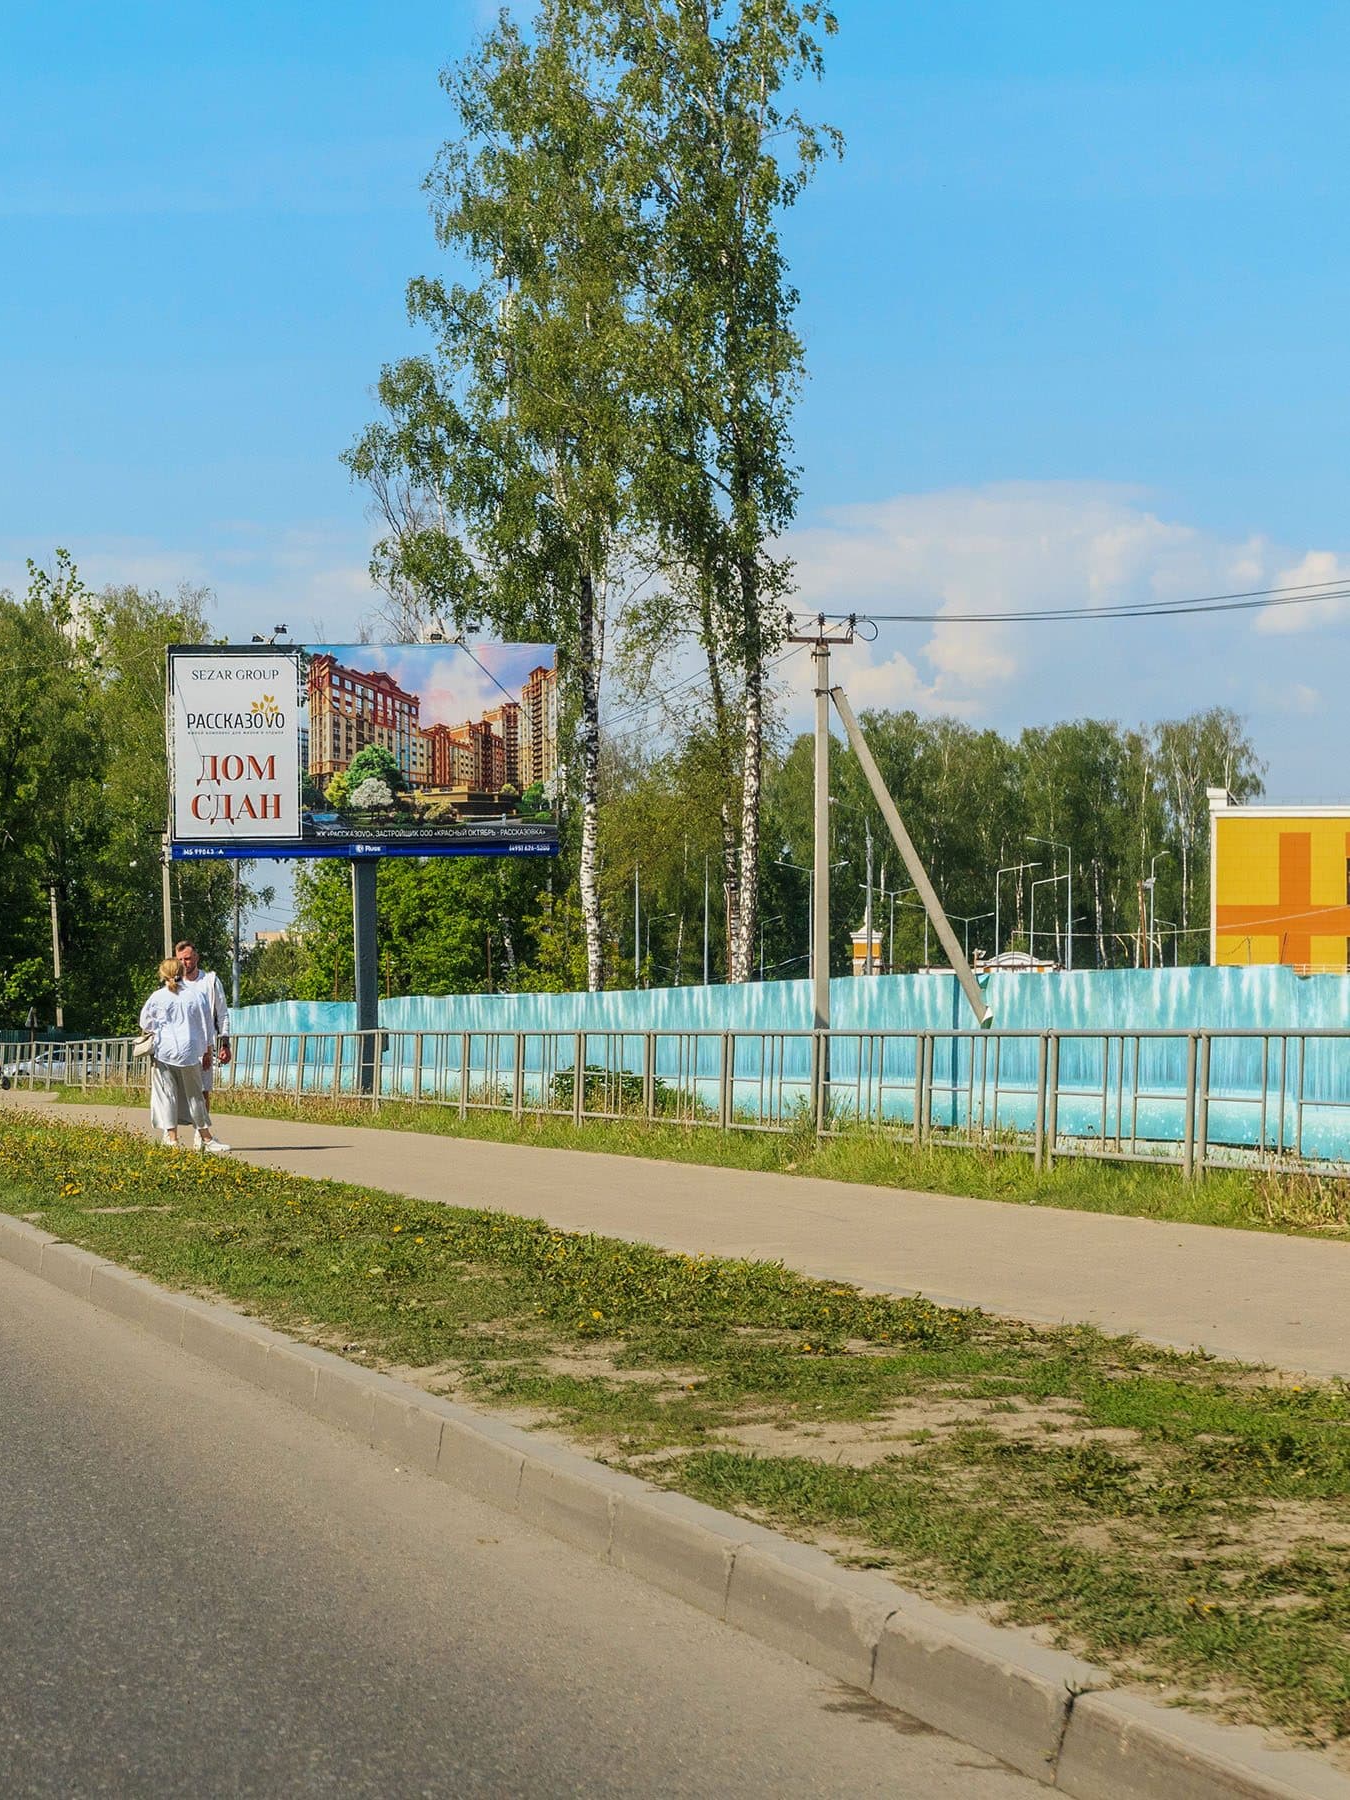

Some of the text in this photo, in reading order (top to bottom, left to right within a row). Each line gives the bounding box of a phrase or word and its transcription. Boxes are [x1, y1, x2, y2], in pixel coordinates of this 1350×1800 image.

[191, 669, 279, 680] SEZAR GROUP
[196, 754, 276, 787] ДОМ
[191, 793, 282, 826] СДАН
